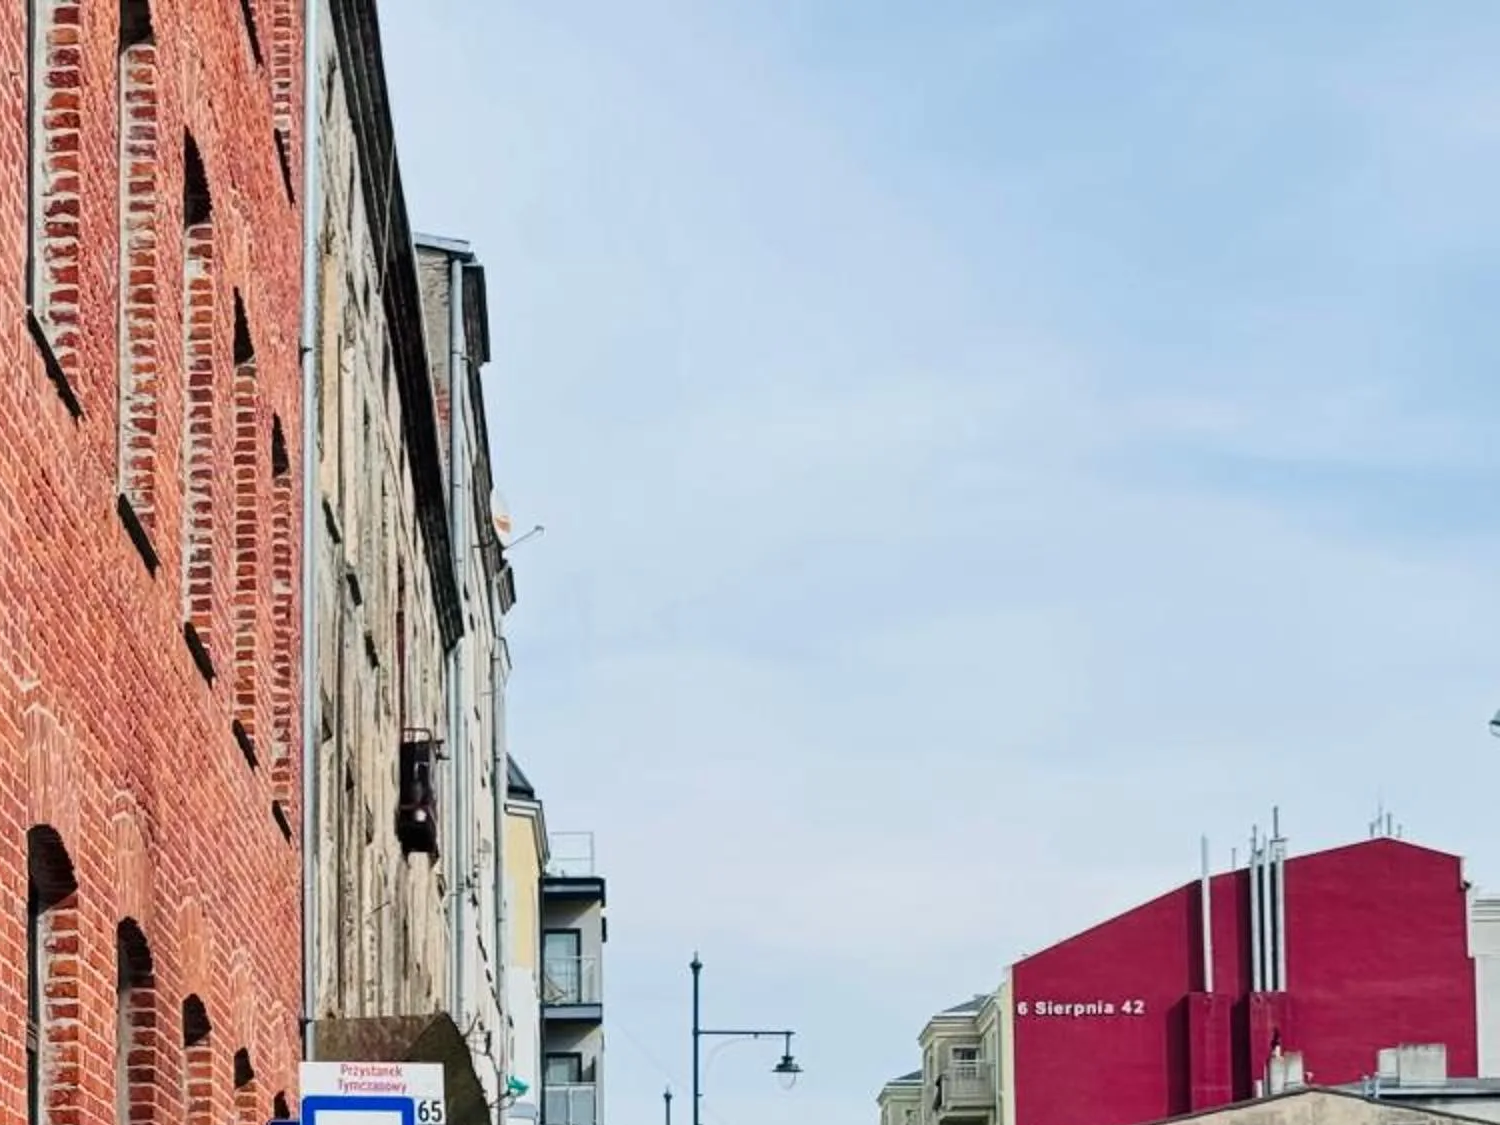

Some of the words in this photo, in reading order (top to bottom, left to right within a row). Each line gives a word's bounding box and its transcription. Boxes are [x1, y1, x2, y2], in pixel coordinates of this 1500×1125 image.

[1017, 1001, 1028, 1015] 6
[1035, 1001, 1114, 1016] Sierpnia
[1121, 999, 1145, 1014] 42
[340, 1063, 403, 1078] Przystanek
[417, 1100, 443, 1122] 65
